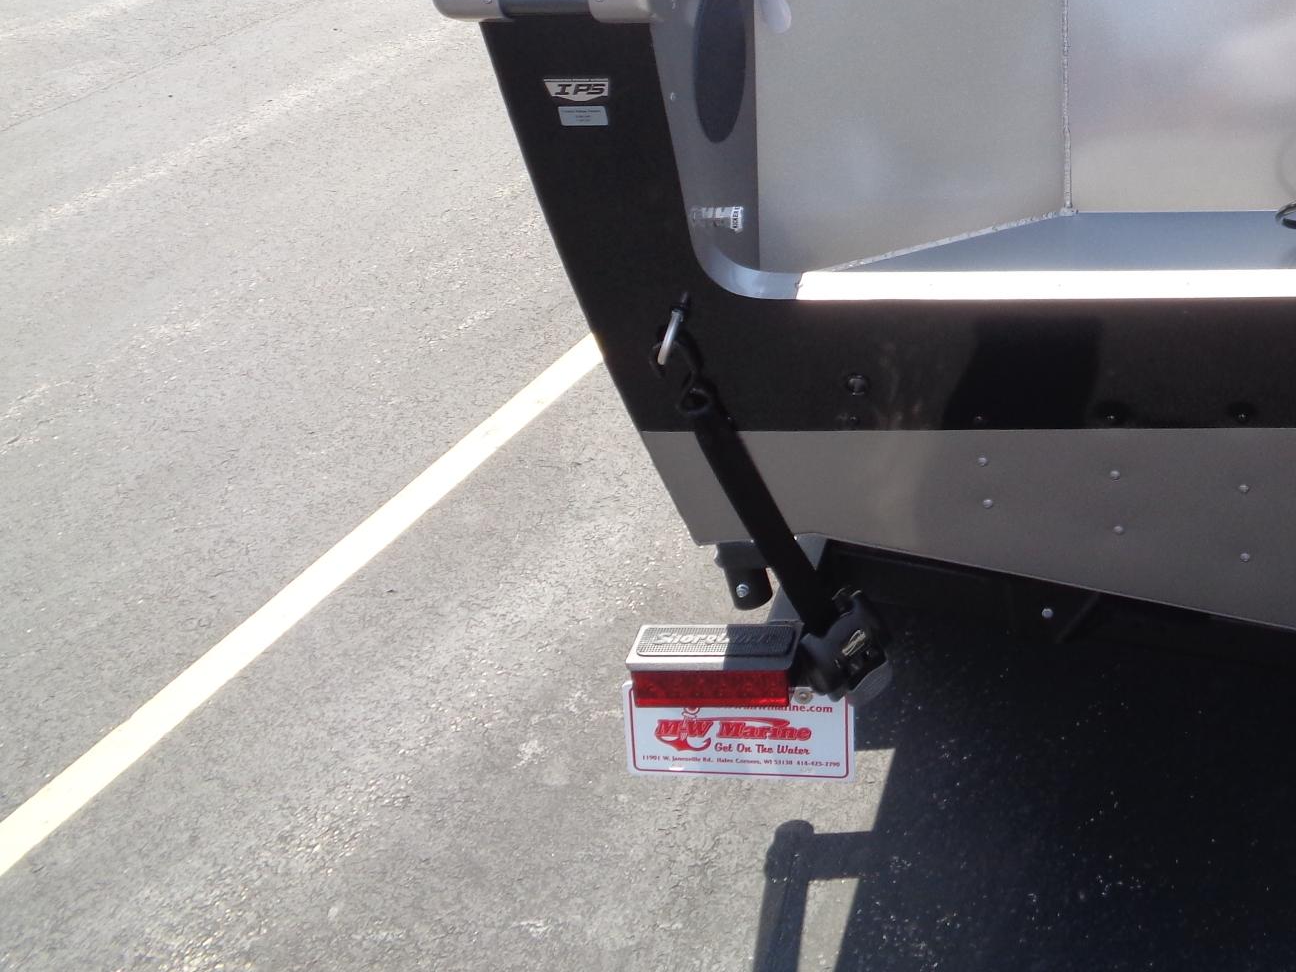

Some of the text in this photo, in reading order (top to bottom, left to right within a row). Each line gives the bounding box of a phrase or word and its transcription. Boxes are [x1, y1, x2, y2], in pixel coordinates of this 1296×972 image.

[655, 719, 812, 741] M-W Marine
[714, 742, 810, 755] Get On The Water
